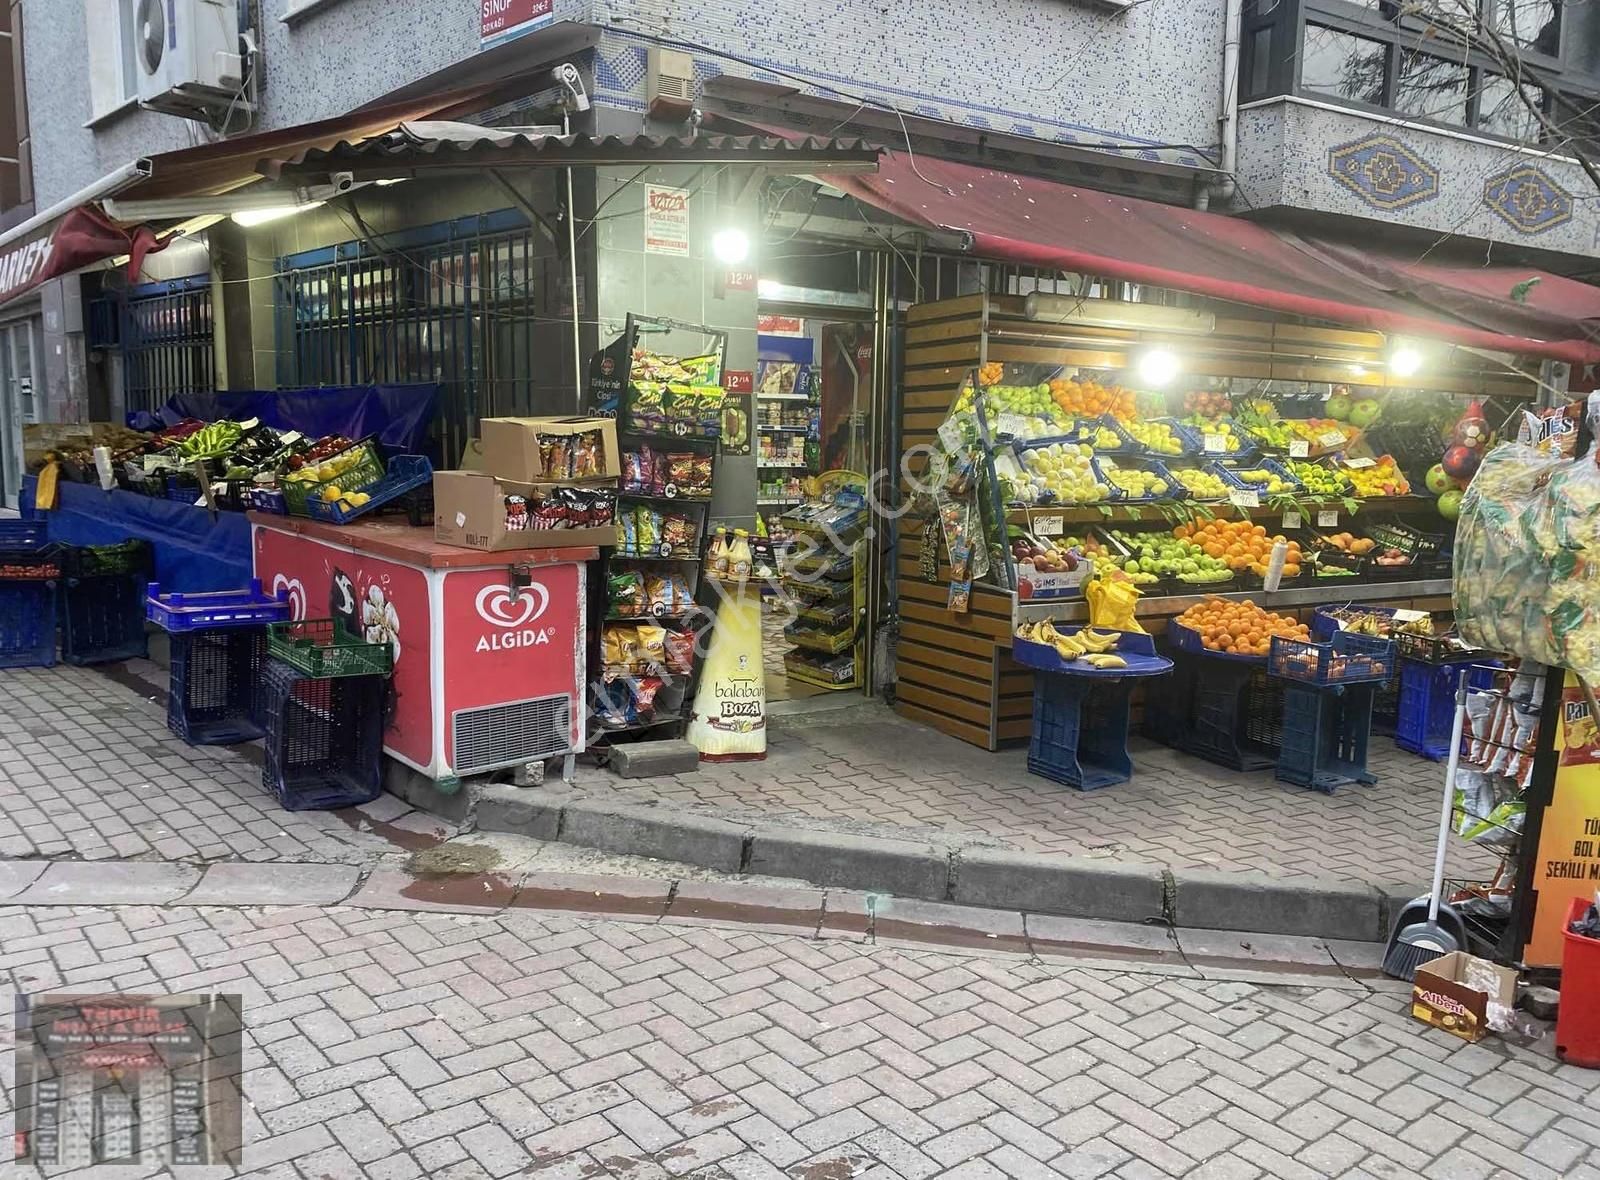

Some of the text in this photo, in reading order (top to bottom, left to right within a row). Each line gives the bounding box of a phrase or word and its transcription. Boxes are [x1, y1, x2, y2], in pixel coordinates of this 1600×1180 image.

[1573, 840, 1593, 857] BOL
[1589, 863, 1600, 880] M
[1419, 990, 1465, 1016] Albeni
